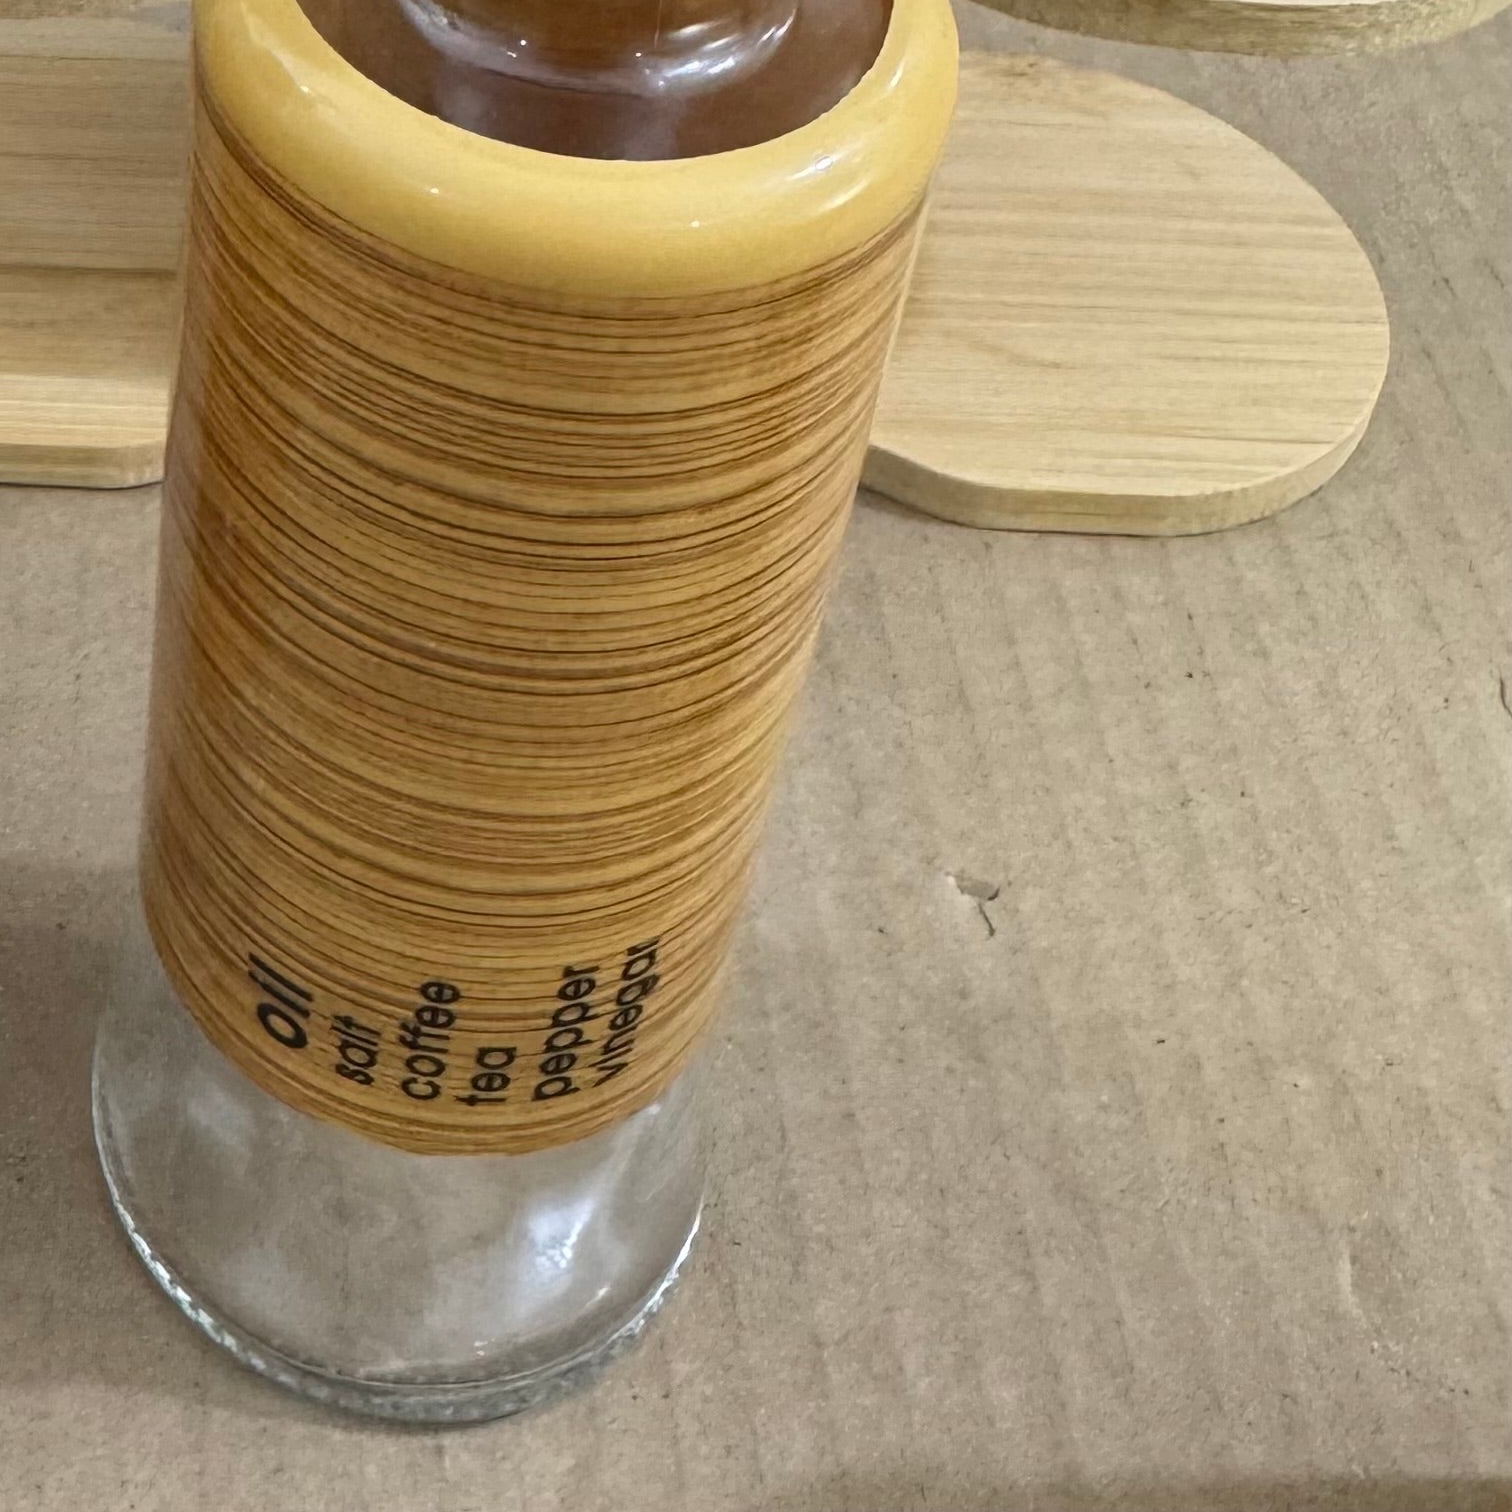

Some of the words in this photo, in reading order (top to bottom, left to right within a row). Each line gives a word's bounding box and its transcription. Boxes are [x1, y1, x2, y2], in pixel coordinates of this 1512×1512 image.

[248, 951, 315, 1049] oil
[327, 1013, 382, 1086] salt
[399, 980, 461, 1101] coffee
[530, 964, 601, 1103] pepper
[588, 935, 661, 1088] vinegar
[453, 1045, 518, 1107] tea
